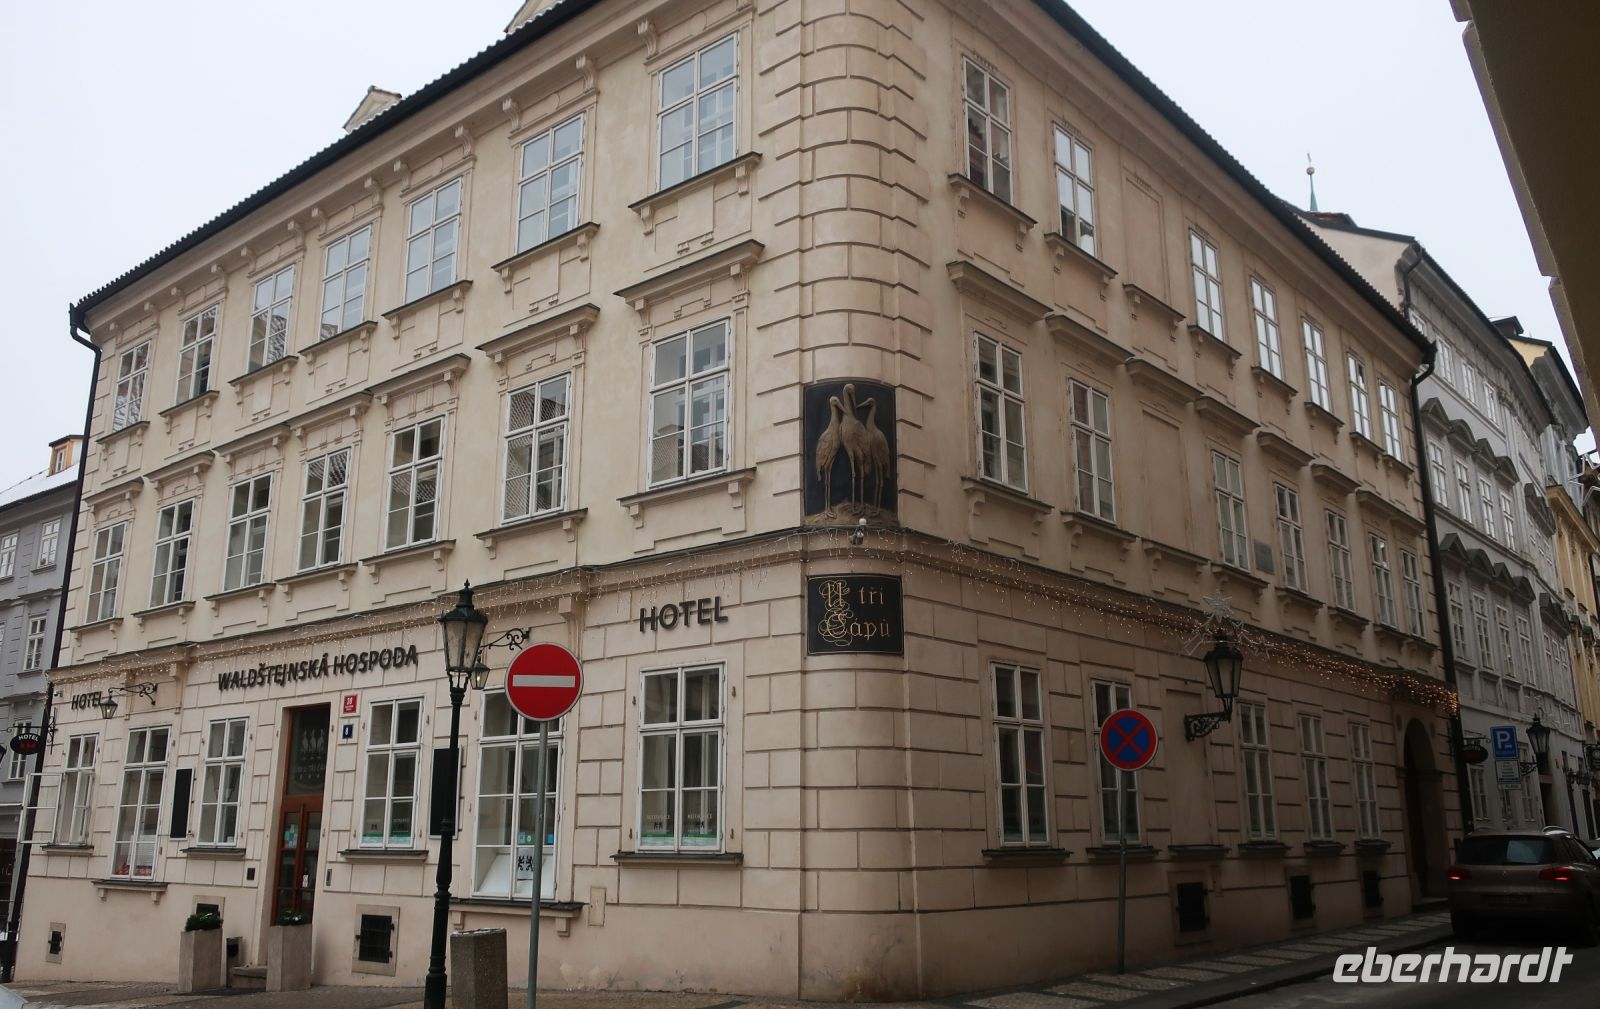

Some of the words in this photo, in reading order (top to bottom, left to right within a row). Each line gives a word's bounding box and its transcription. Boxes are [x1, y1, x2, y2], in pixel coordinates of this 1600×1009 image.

[640, 596, 729, 633] HOTEL
[218, 652, 330, 691] WALDŠTEJNSKÁ
[333, 644, 418, 676] HOSPODA
[71, 691, 103, 711] HOTEL
[18, 733, 39, 743] HOTEL
[1496, 730, 1511, 749] P
